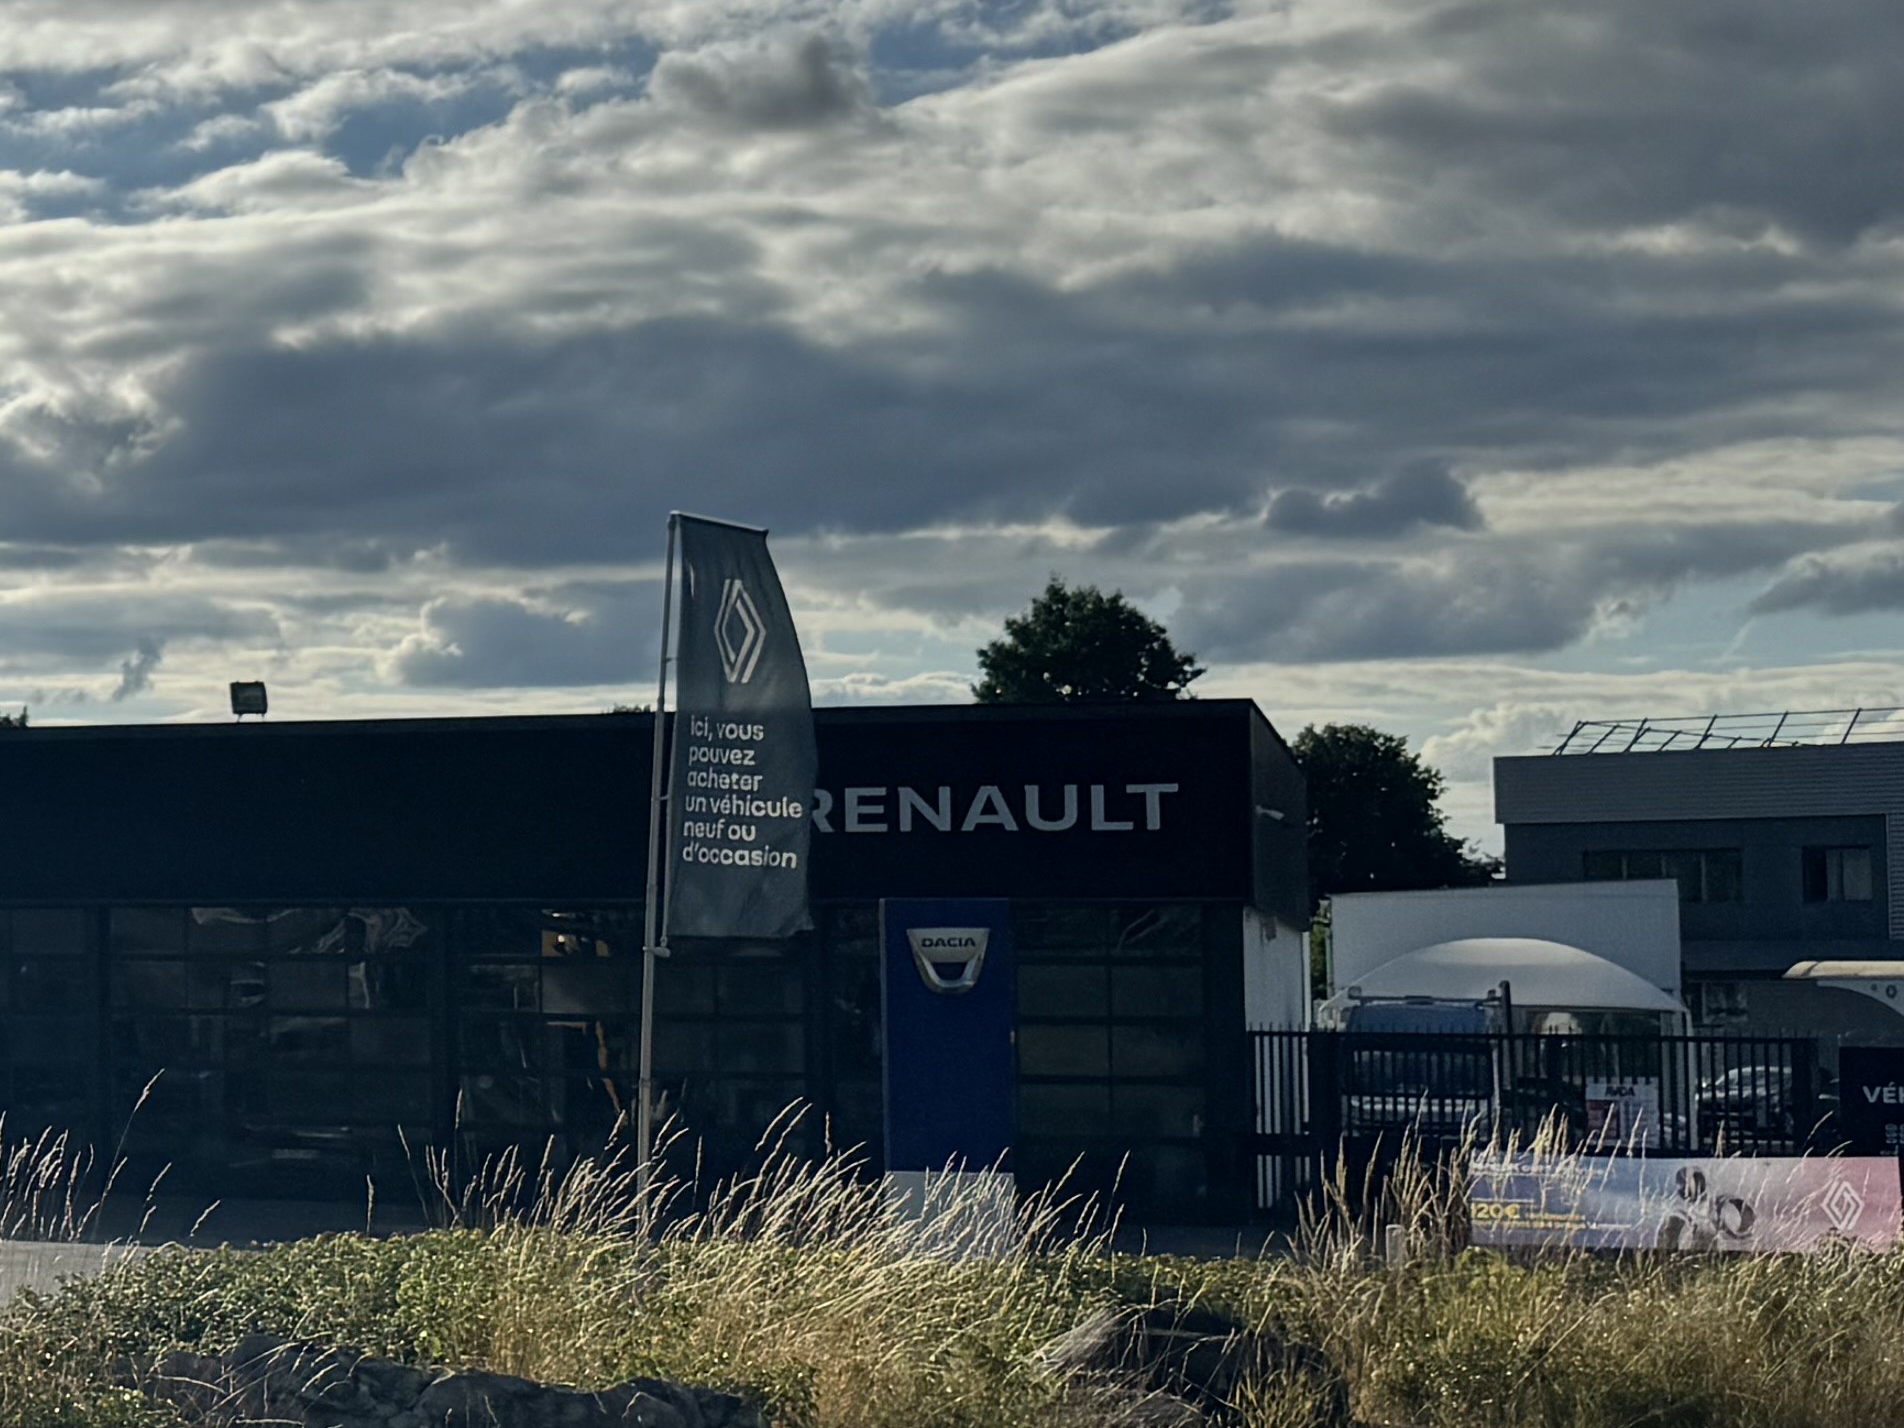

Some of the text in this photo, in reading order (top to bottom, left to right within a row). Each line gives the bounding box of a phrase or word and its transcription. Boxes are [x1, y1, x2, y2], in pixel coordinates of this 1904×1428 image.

[716, 723, 765, 741] vous
[689, 746, 756, 766] pouvez
[687, 767, 763, 792] acheter
[685, 794, 803, 818] un véhicule
[683, 818, 757, 841] neuf ou
[922, 937, 976, 947] DACIA
